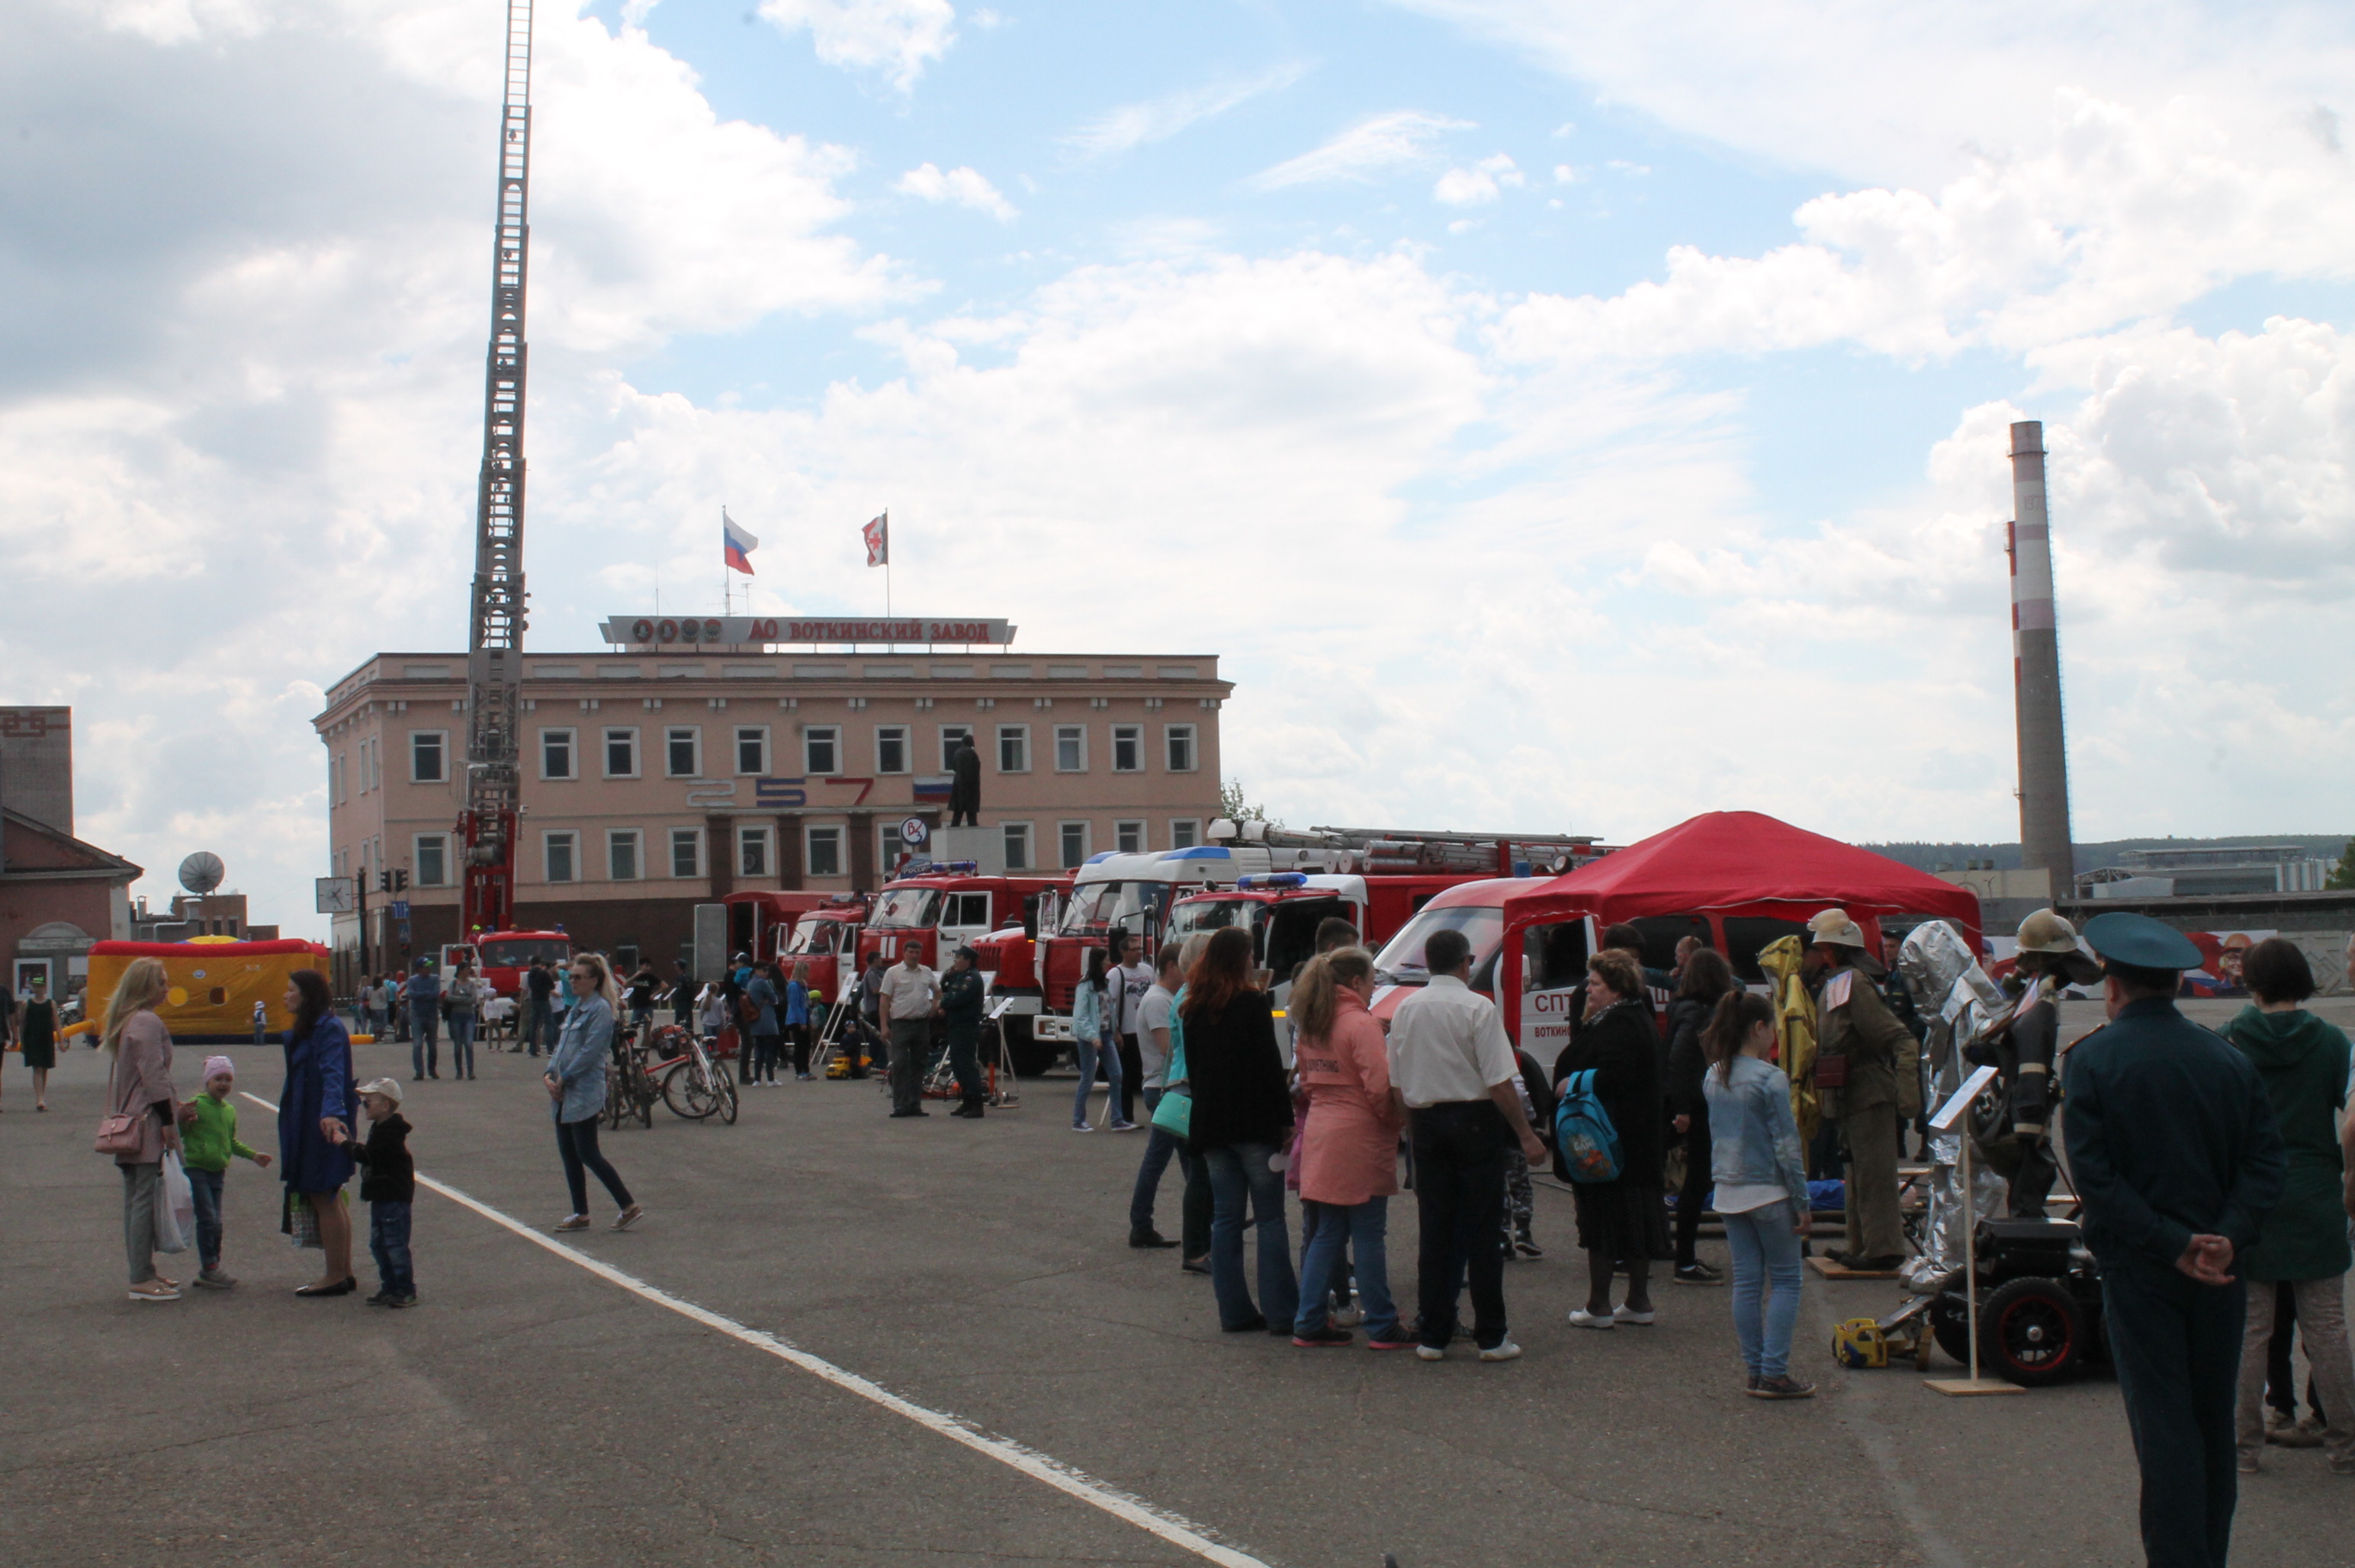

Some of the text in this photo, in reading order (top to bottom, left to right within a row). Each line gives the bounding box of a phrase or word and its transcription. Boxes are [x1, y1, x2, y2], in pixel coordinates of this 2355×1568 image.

[749, 618, 989, 643] АО ВОТКИНСКИЙ ЗАВОД
